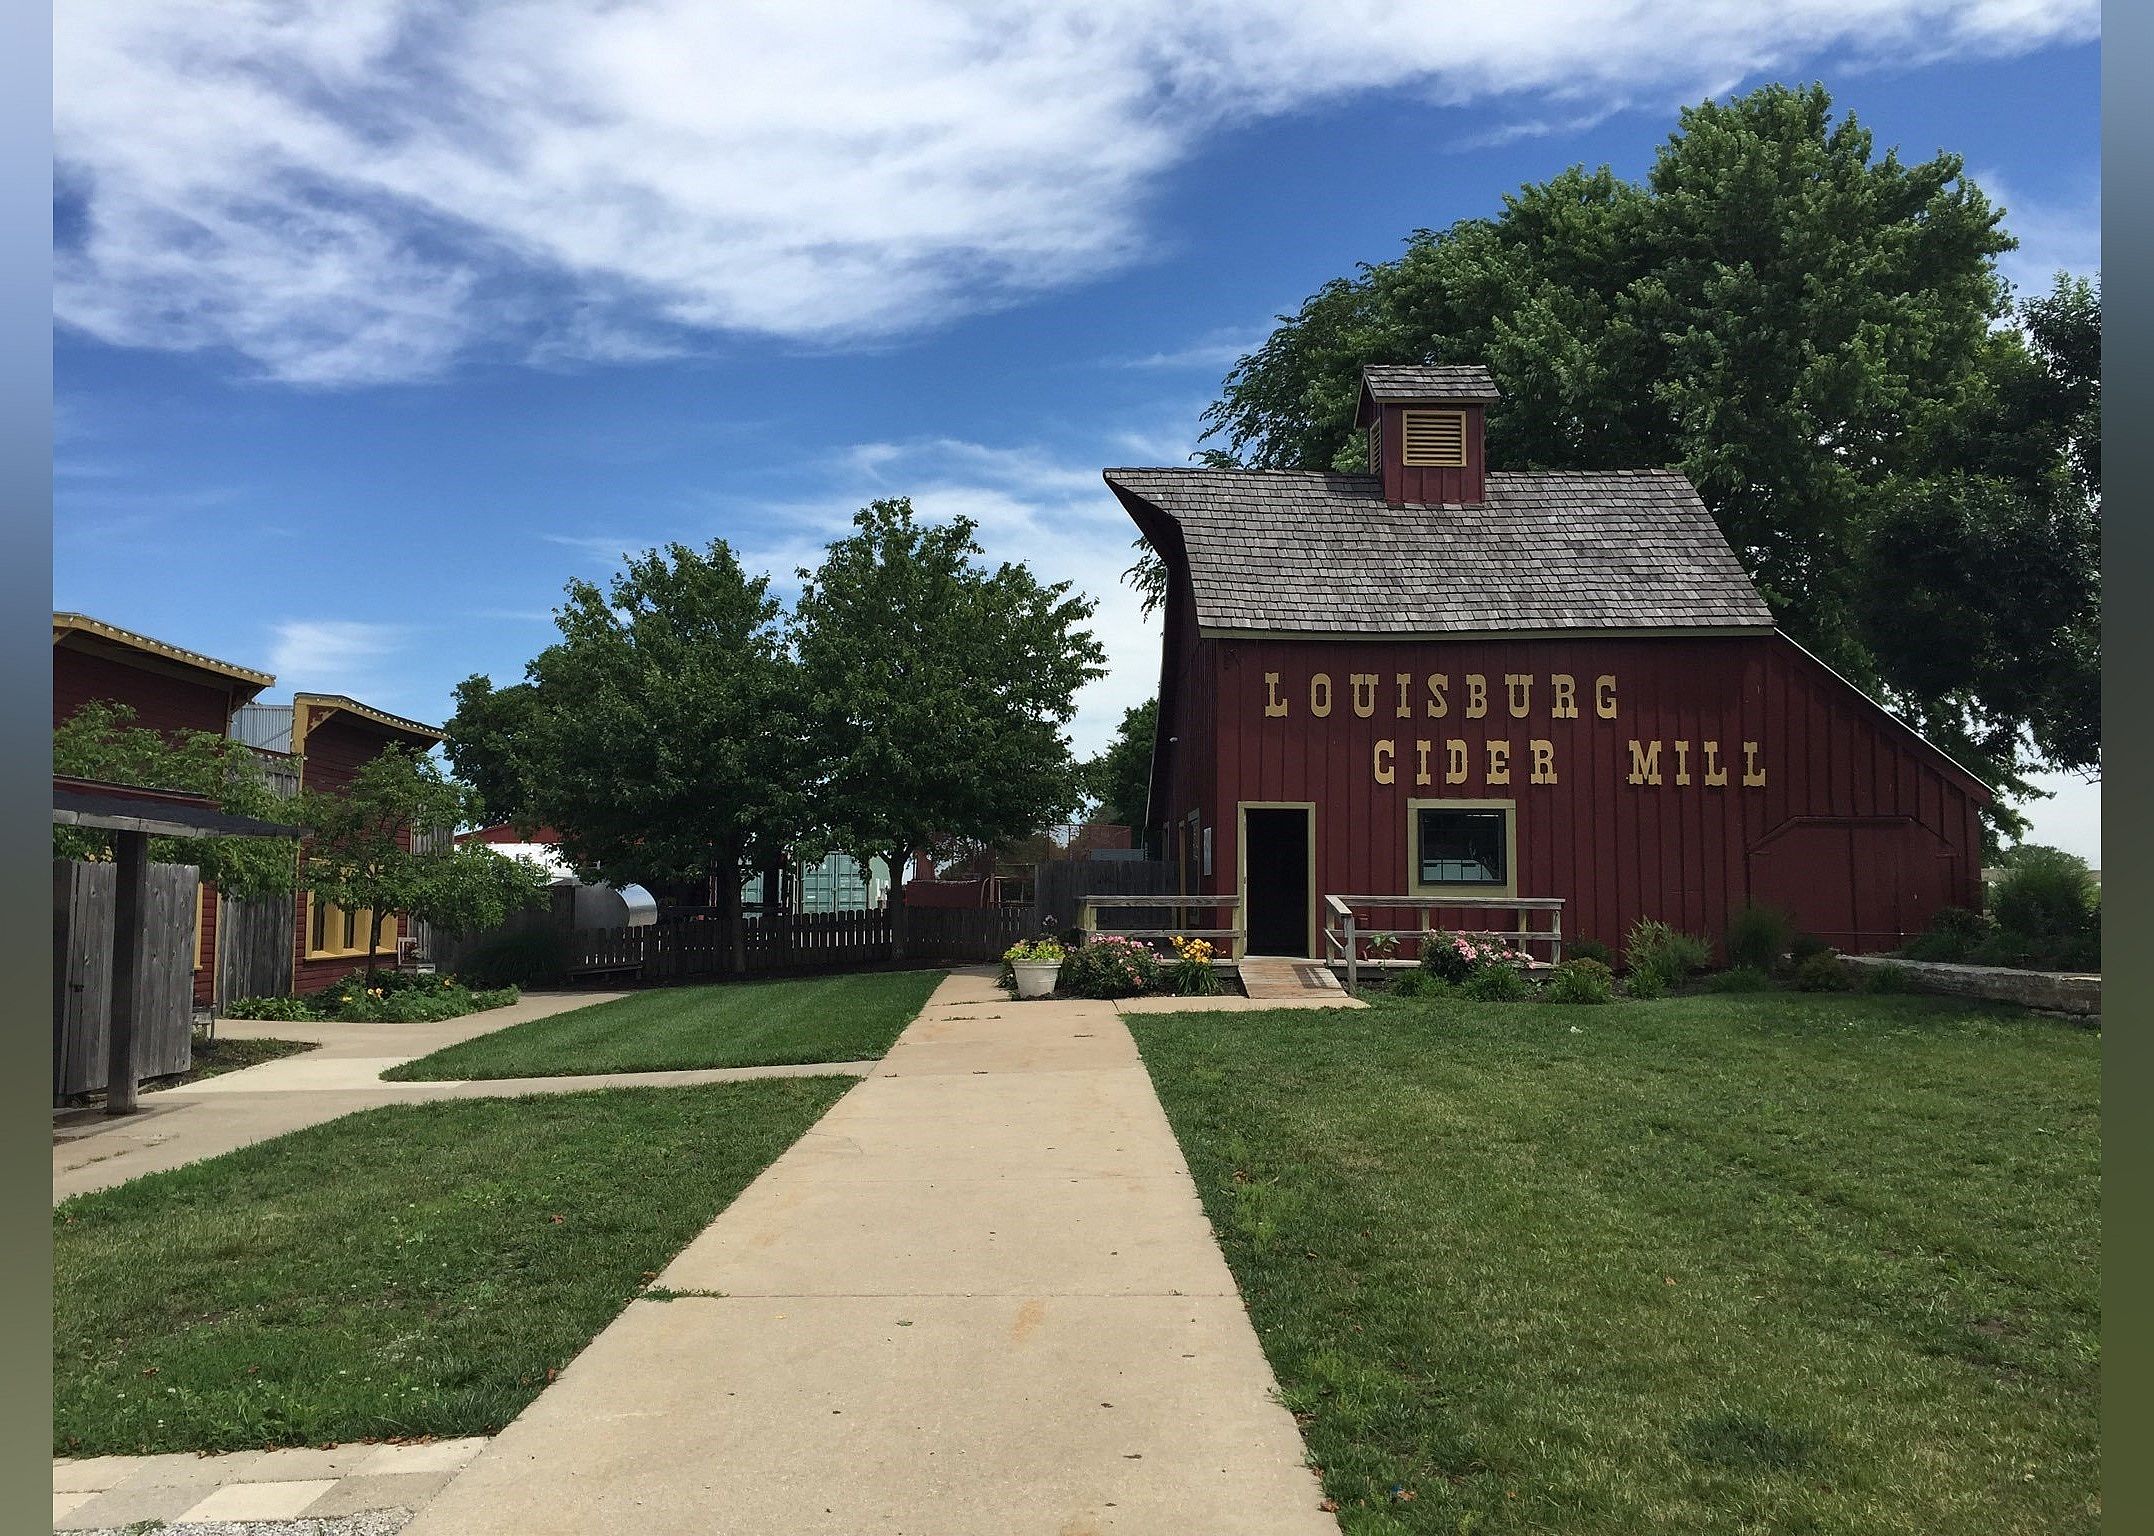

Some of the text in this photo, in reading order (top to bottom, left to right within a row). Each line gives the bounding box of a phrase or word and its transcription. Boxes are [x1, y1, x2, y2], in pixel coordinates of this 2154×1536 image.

[1264, 672, 1618, 720] LOUISBURG
[1373, 739, 1767, 787] CIDER MILL
